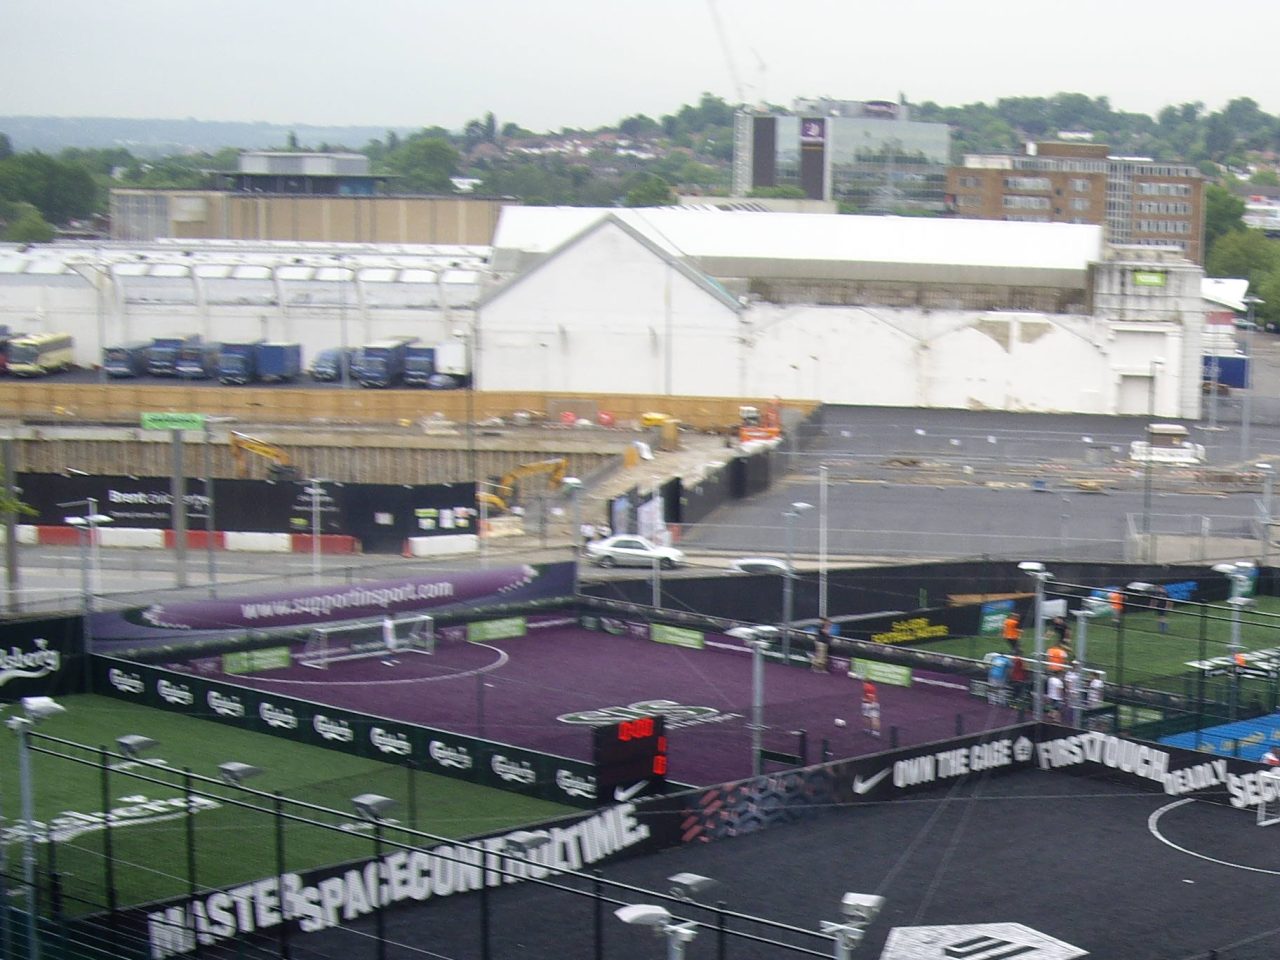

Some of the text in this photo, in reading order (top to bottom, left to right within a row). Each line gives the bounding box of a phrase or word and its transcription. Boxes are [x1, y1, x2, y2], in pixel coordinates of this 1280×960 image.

[893, 754, 936, 788] OWN
[935, 747, 970, 778] THE
[1087, 730, 1170, 783] TOUCH
[147, 872, 304, 960] MASTER
[299, 850, 411, 933] SPACE
